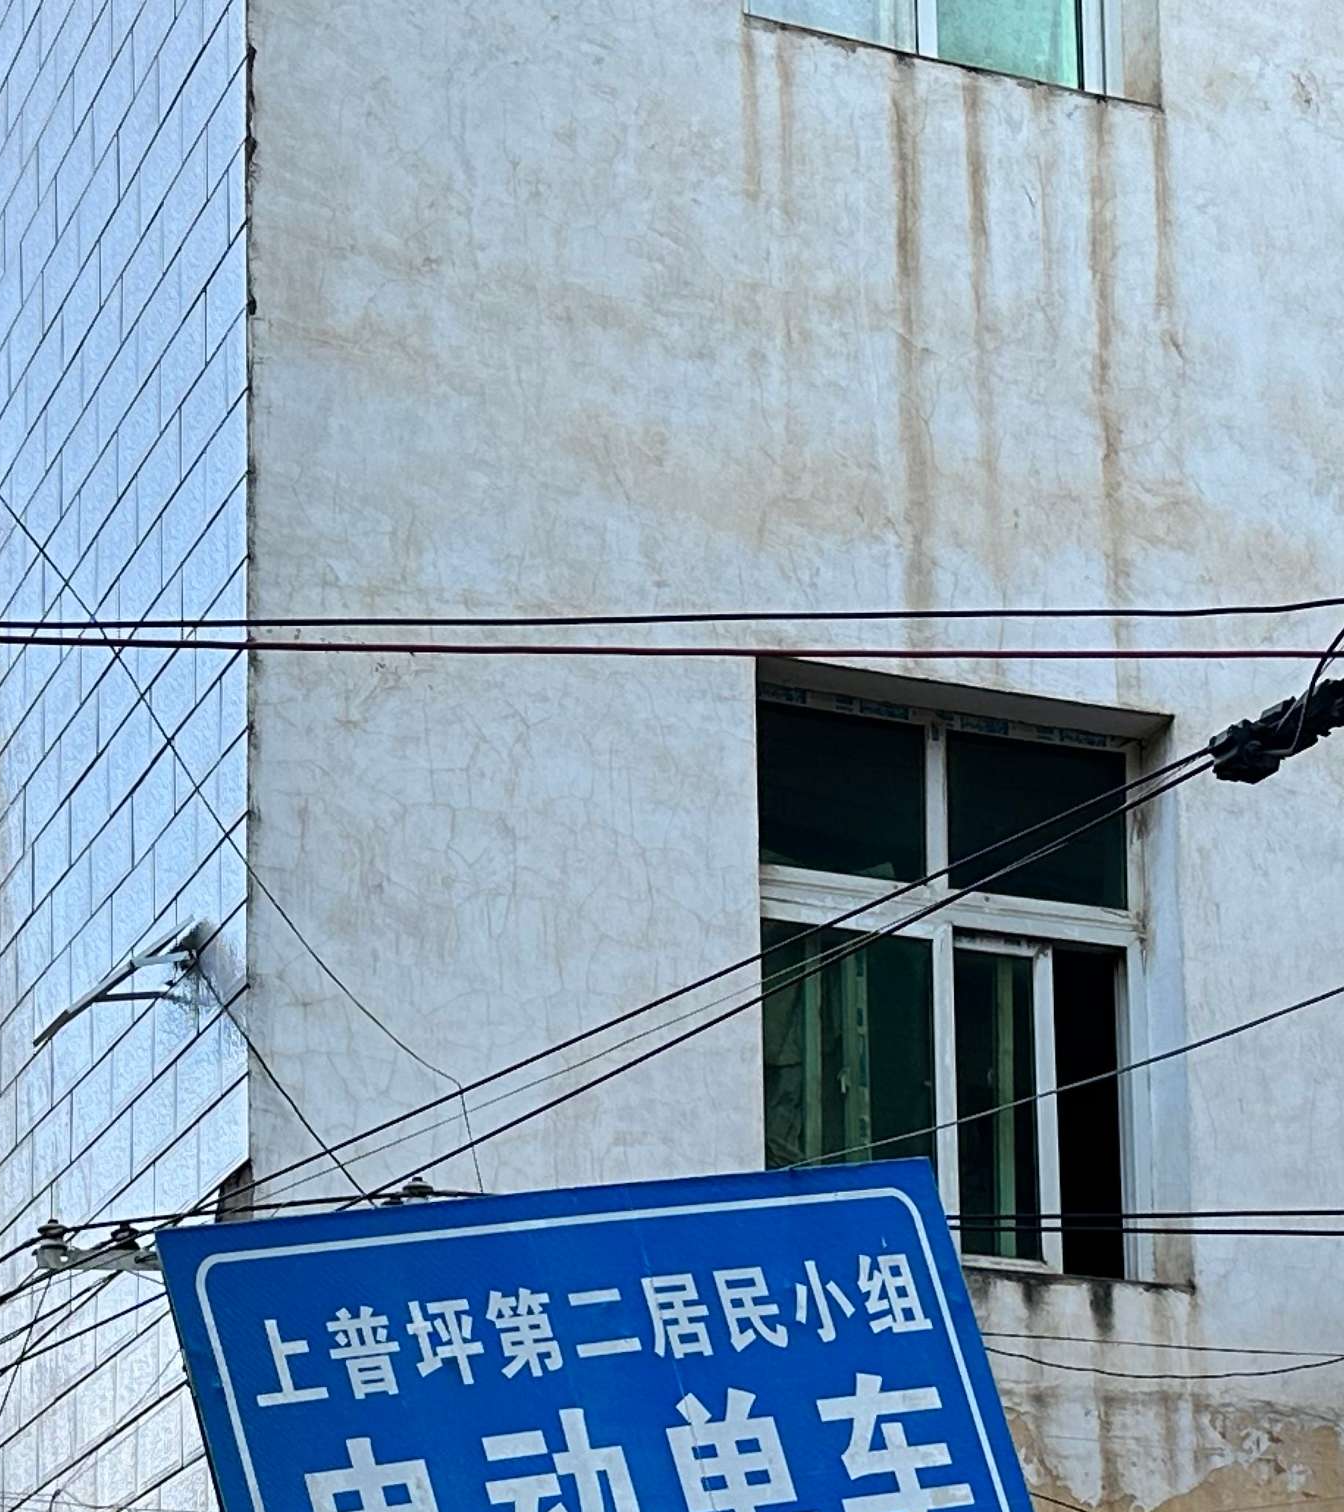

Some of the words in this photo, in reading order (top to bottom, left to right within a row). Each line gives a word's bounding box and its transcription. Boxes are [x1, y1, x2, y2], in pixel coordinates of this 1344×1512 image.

[255, 1253, 933, 1408] 上普坪第二居民小组
